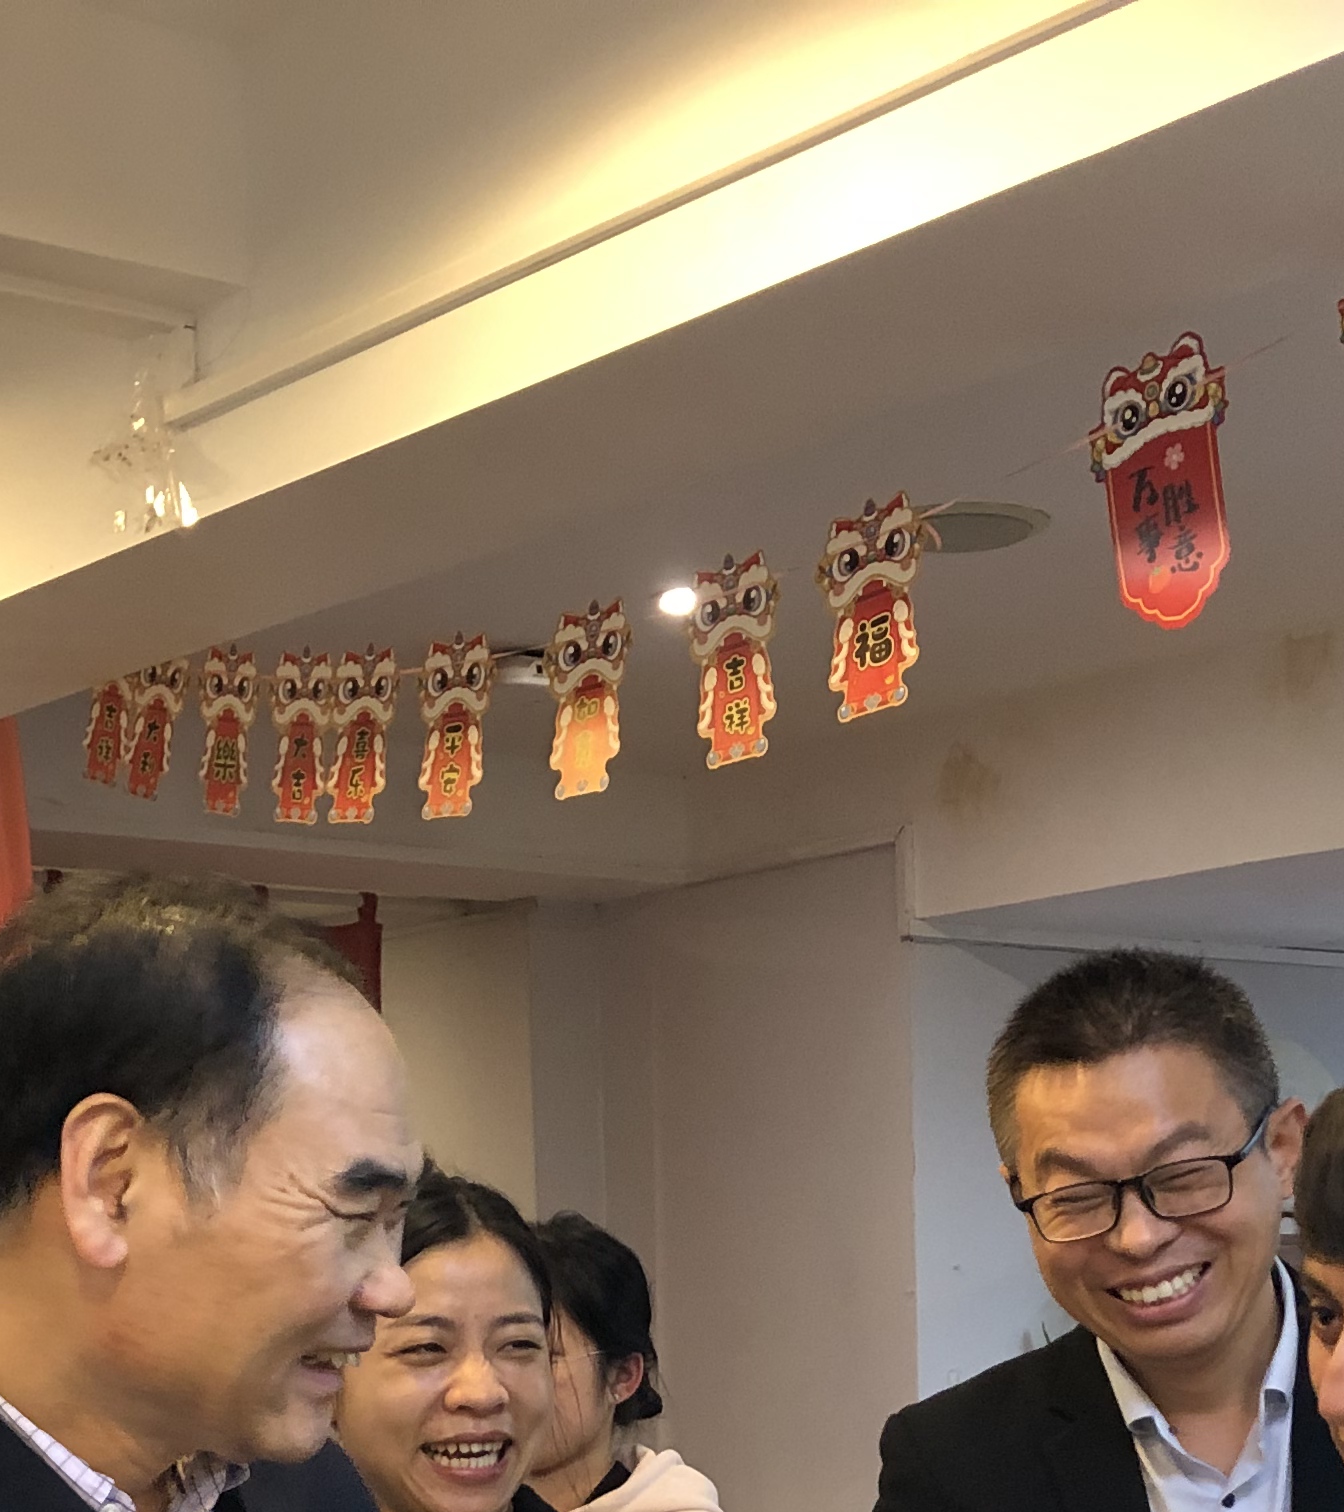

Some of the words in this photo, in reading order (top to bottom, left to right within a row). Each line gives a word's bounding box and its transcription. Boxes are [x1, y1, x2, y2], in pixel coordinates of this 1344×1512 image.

[854, 612, 895, 671] 福
[723, 655, 752, 735] 吉祥
[213, 736, 236, 782] 樂
[290, 732, 308, 802] 大吉
[347, 727, 370, 799] 喜乐
[440, 722, 464, 797] 平安
